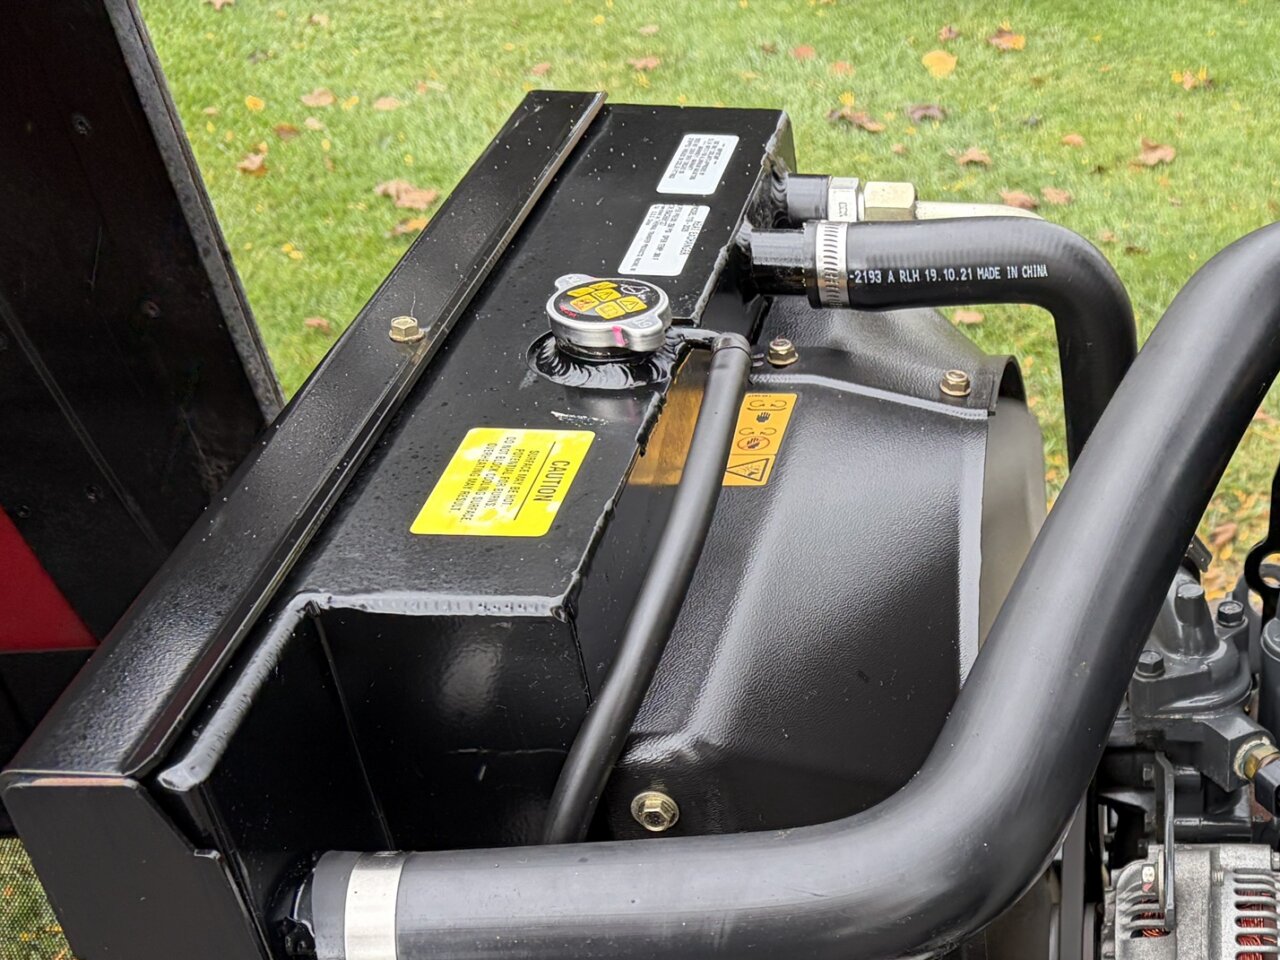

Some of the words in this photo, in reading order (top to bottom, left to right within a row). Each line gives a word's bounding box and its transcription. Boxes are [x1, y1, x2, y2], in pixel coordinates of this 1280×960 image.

[850, 270, 882, 284] -2193
[888, 270, 895, 283] A
[899, 269, 920, 283] RLH
[925, 267, 974, 283] 19.10.21
[977, 266, 1001, 280] MADE
[1007, 265, 1019, 279] IN
[1022, 264, 1049, 279] CHINA
[468, 443, 498, 476] OVERHEATING
[496, 445, 512, 454] NOT
[486, 456, 506, 471] BLOCK
[501, 448, 525, 475] POTENTIAL
[518, 450, 540, 472] SURFACE
[461, 478, 477, 489] MAY
[473, 472, 496, 495] COOLING
[494, 476, 510, 486] FOR
[511, 473, 528, 484] MAY
[532, 460, 571, 501] CAUTION
